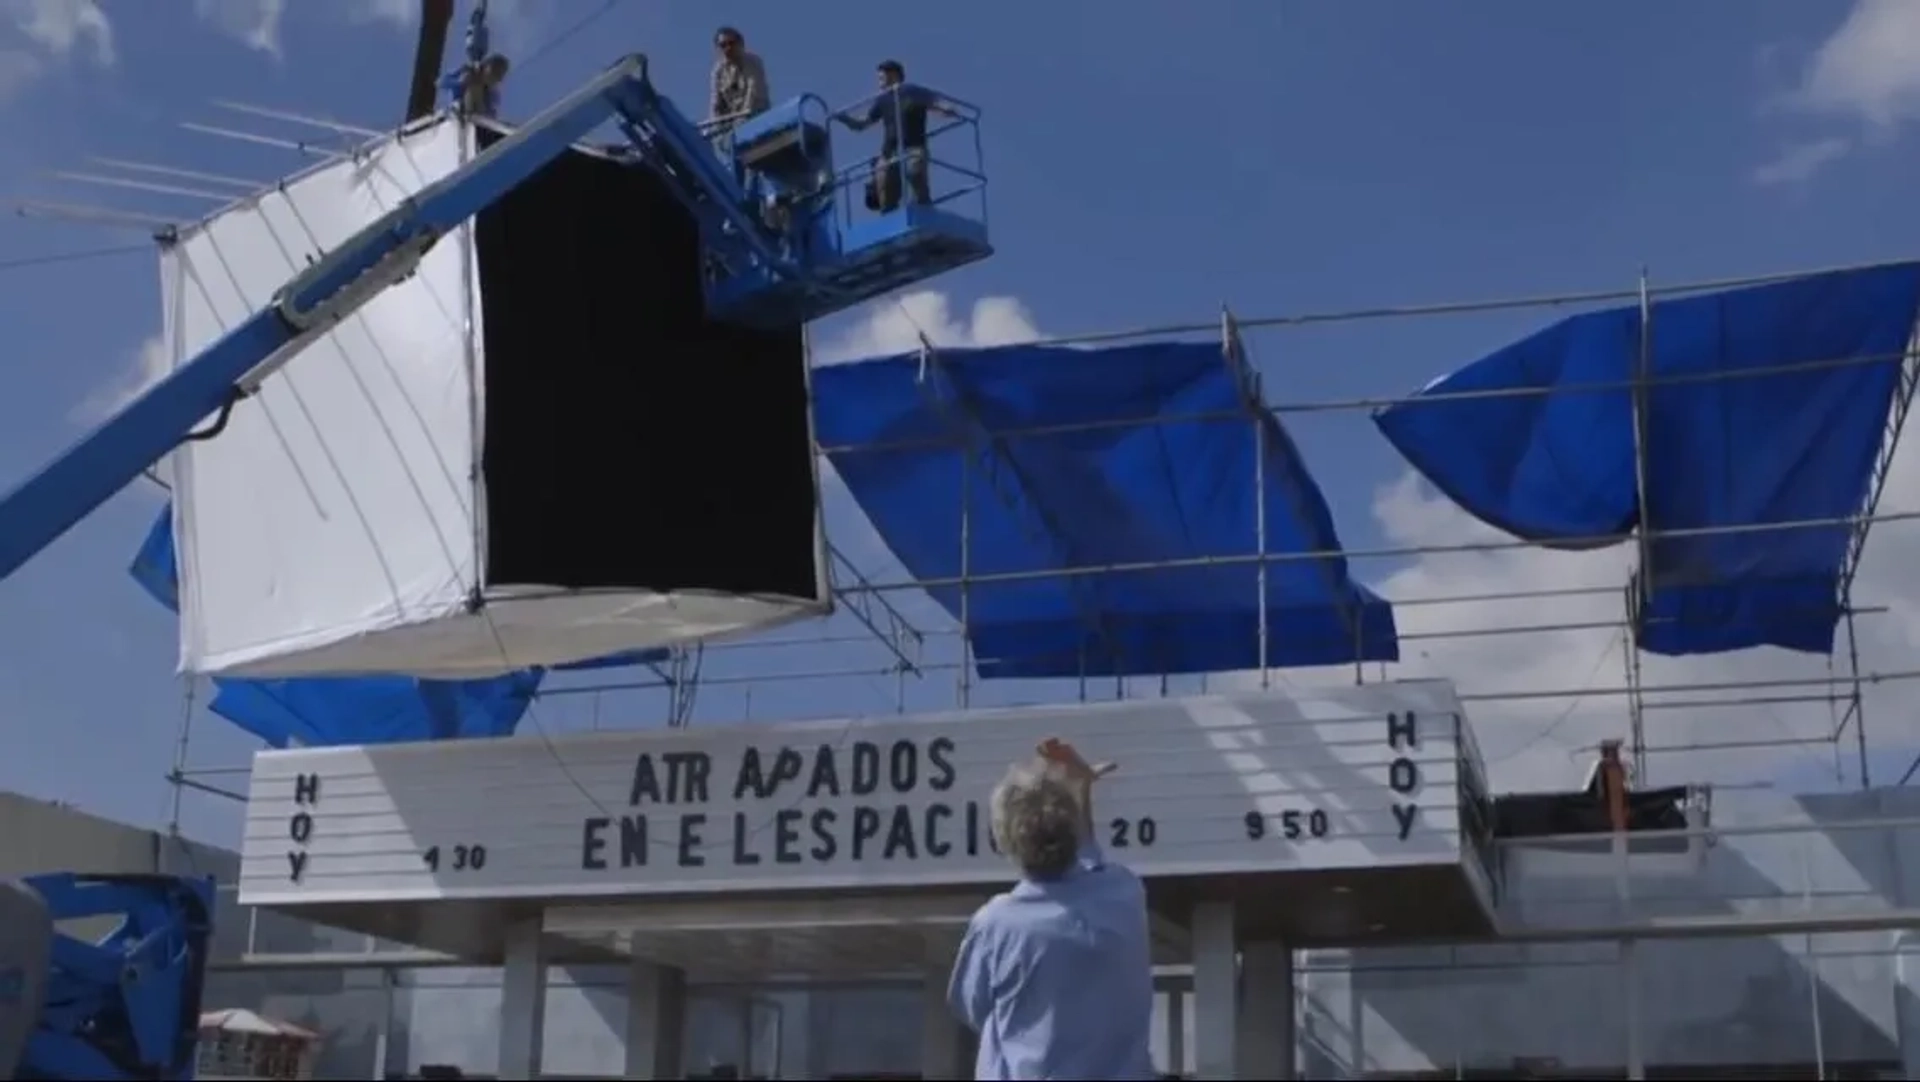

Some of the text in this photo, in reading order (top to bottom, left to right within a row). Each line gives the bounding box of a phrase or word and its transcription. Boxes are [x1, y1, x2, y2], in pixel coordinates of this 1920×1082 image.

[1386, 710, 1417, 841] HOY
[287, 773, 319, 884] HOY
[582, 813, 649, 870] EN
[1110, 817, 1157, 848] 20
